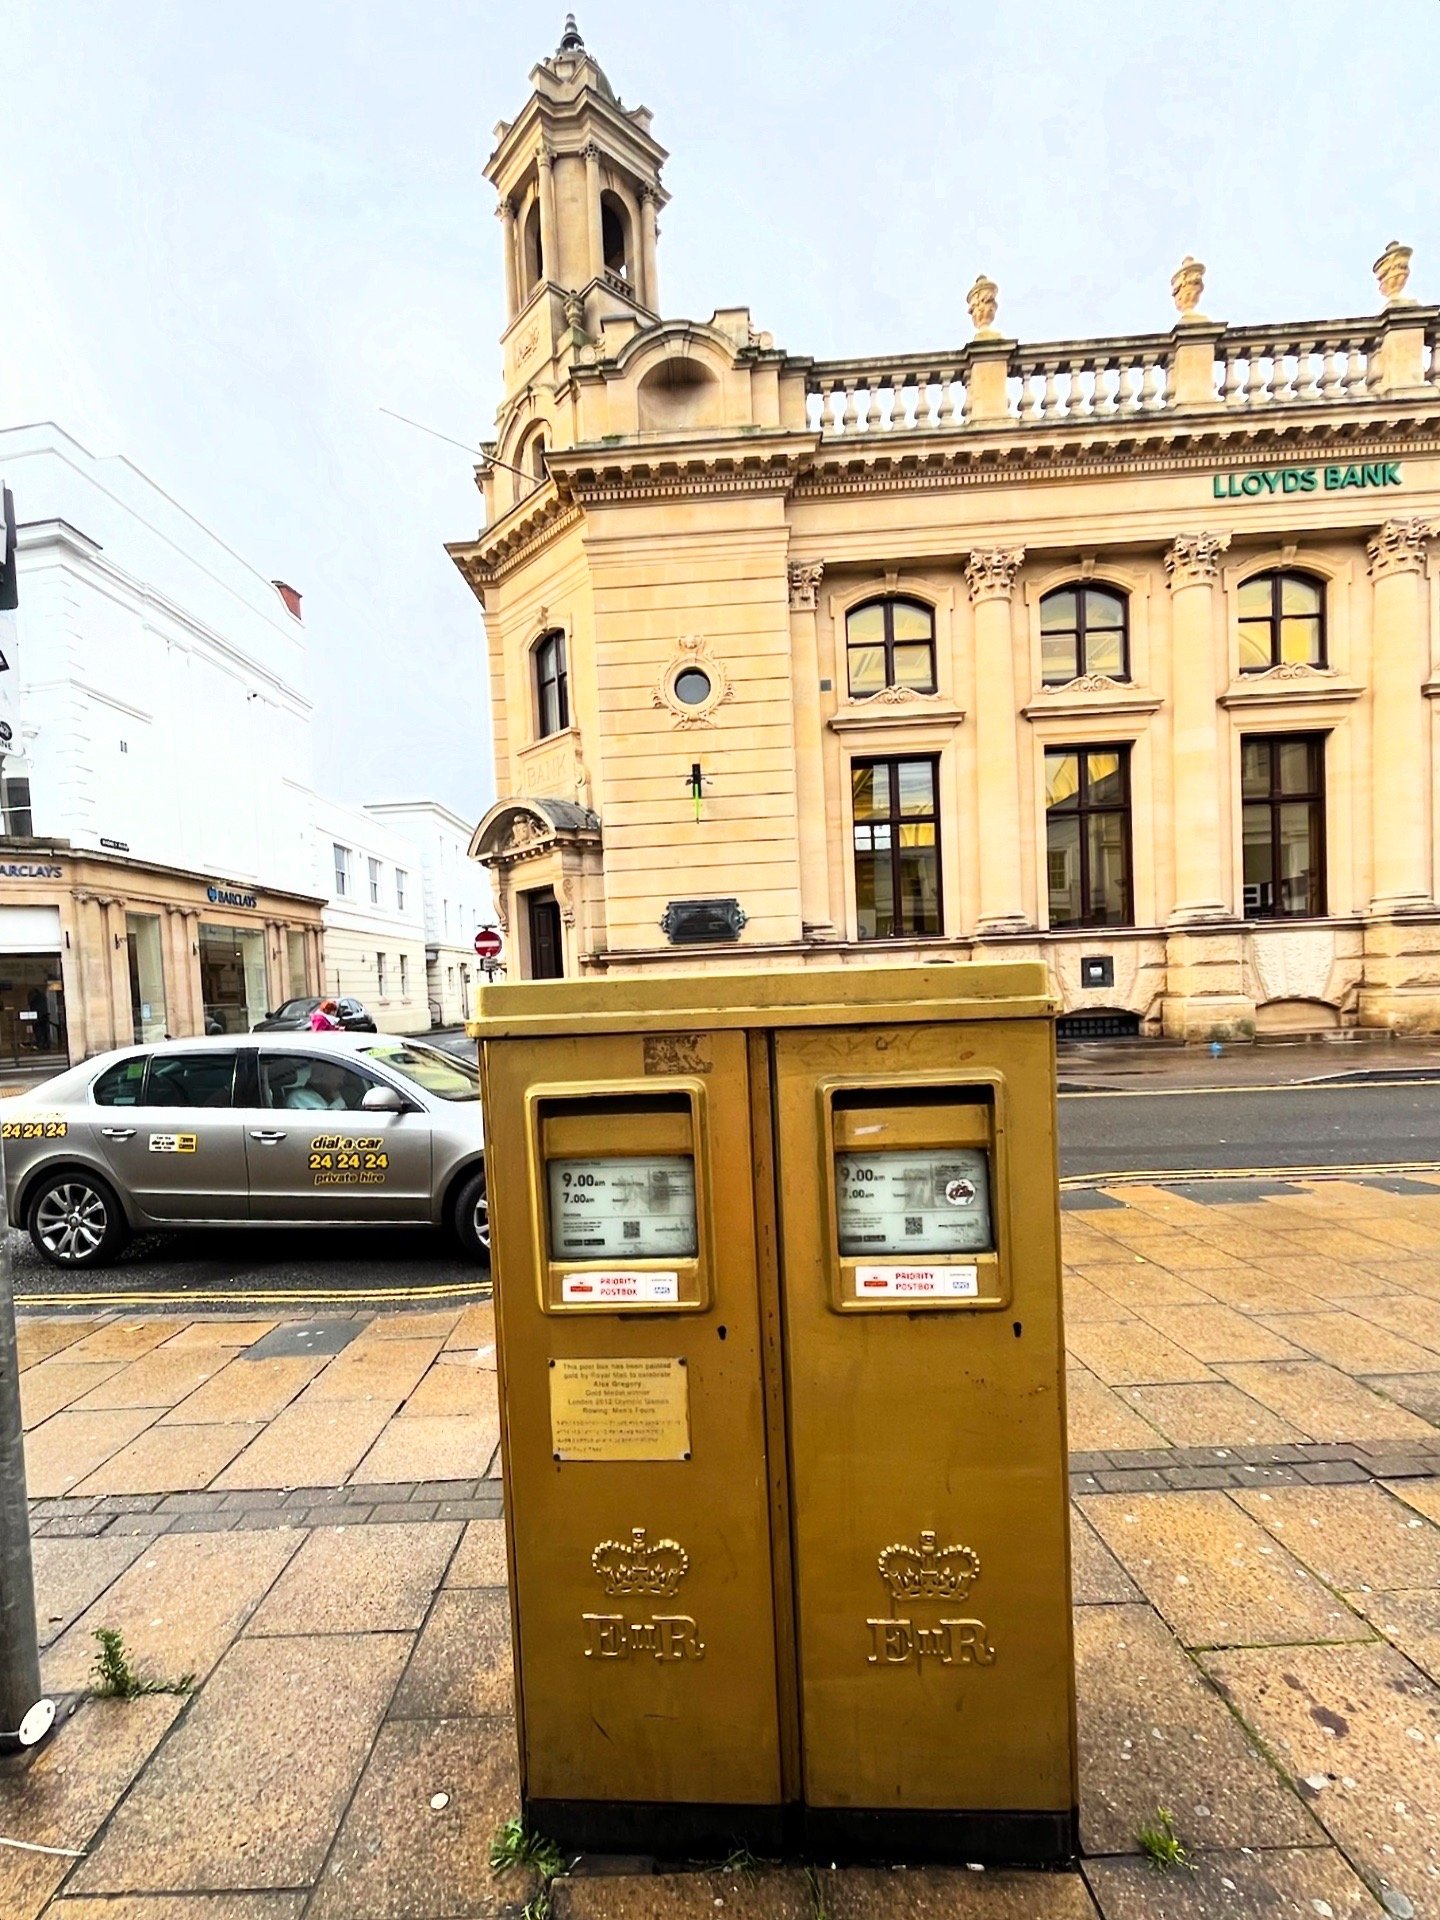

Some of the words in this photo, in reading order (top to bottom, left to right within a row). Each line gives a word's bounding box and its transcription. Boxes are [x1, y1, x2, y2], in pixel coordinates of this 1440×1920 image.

[1213, 469, 1319, 498] LLOYDS
[1324, 461, 1402, 490] BANK
[218, 890, 257, 909] BARCLAYS
[2, 1123, 22, 1138] 24
[23, 1122, 44, 1138] 24
[46, 1121, 68, 1137] 24
[311, 1135, 341, 1150] dial
[342, 1138, 355, 1150] a
[357, 1138, 383, 1150] car
[309, 1152, 333, 1169] 24
[337, 1152, 361, 1169] 24
[364, 1152, 389, 1169] 24
[314, 1173, 358, 1185] private
[360, 1172, 385, 1183] hire
[895, 1272, 934, 1280] PRIORITY
[600, 1288, 638, 1296] POSTBOX
